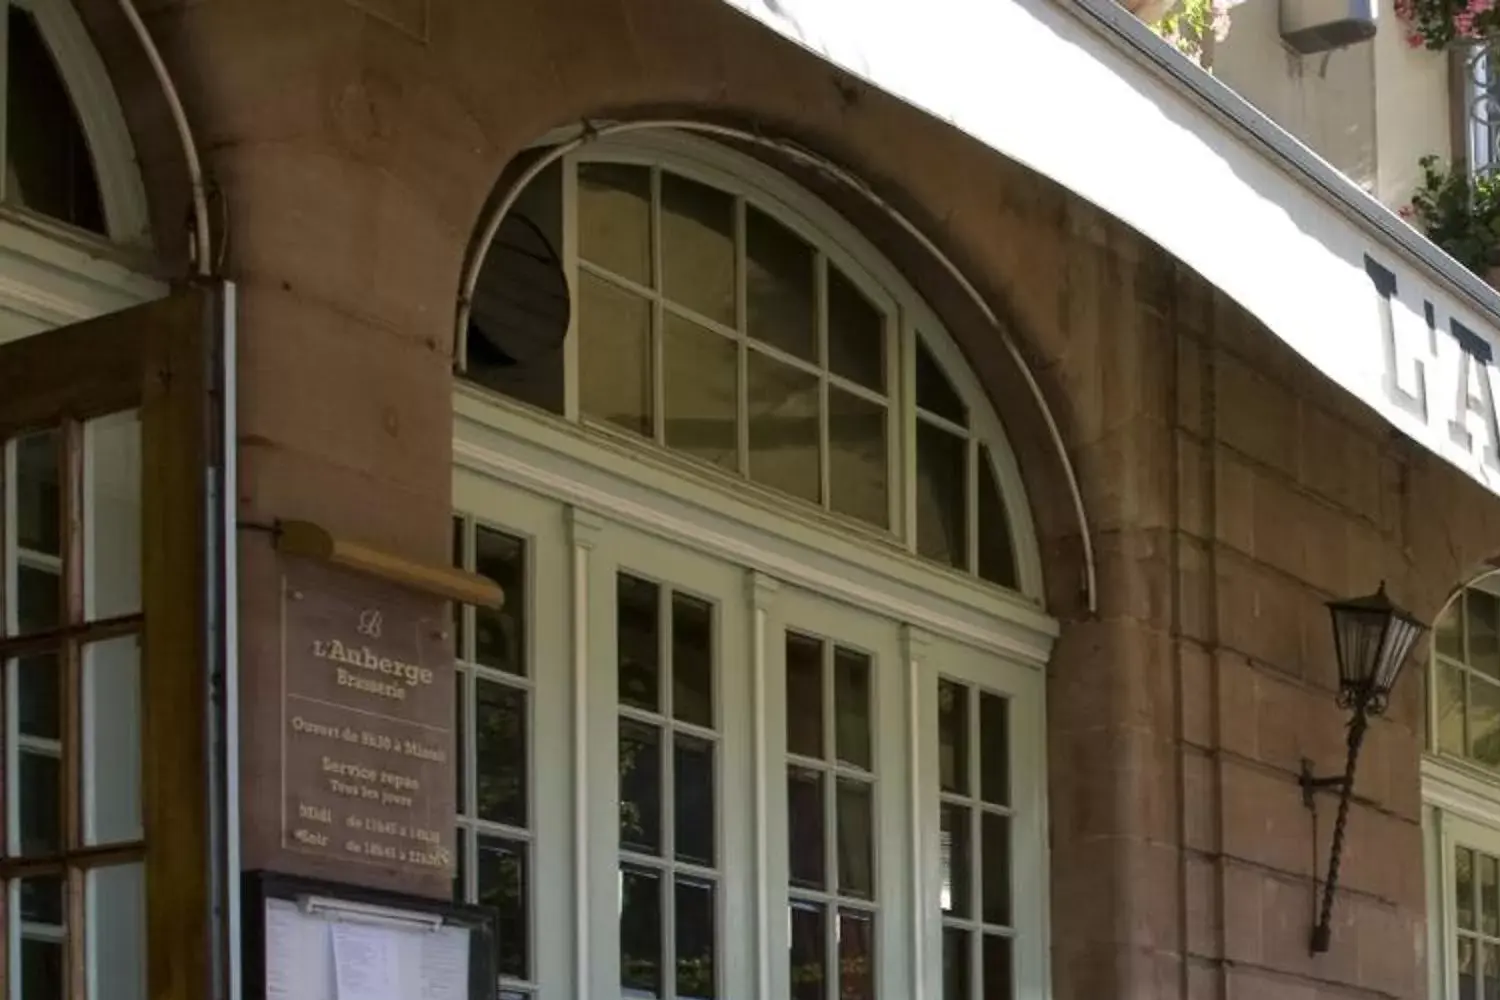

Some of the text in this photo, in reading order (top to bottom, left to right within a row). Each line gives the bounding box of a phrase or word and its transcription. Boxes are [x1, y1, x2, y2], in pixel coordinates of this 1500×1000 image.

[312, 639, 434, 686] L'Auberge
[336, 667, 406, 700] Brasserie
[292, 716, 339, 739] Ouvert
[342, 727, 359, 743] de
[322, 755, 420, 791] Service repas
[330, 779, 359, 796] Tous
[299, 800, 332, 824] Midi
